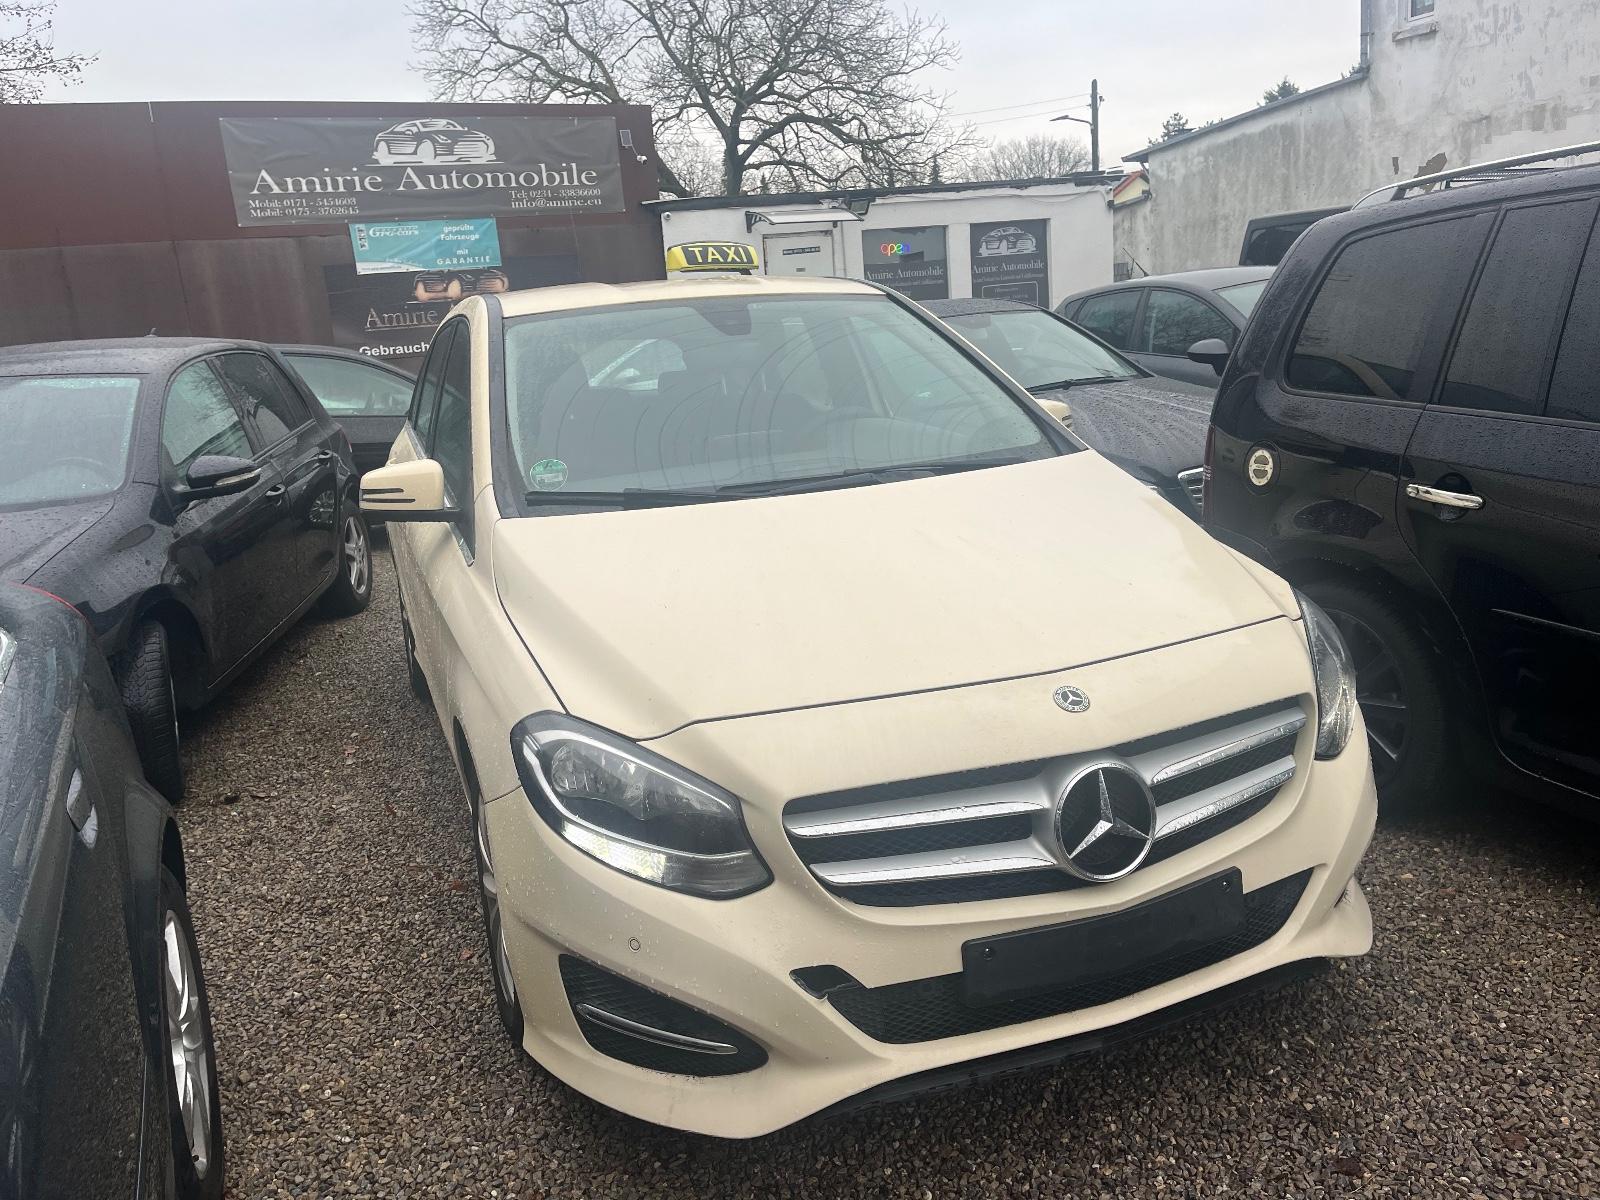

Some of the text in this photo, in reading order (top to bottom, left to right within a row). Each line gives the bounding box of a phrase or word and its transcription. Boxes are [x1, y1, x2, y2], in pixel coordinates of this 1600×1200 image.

[249, 163, 598, 195] Amirie Automobile
[248, 199, 281, 208] Mobil:
[283, 198, 307, 207] 0171
[250, 208, 283, 217] Mobil:
[285, 207, 310, 216] 0175
[687, 246, 748, 263] TAXI
[880, 243, 911, 256] open
[437, 255, 491, 265] GARANTIE
[896, 265, 944, 278] Automobile
[364, 305, 439, 329] Amirie
